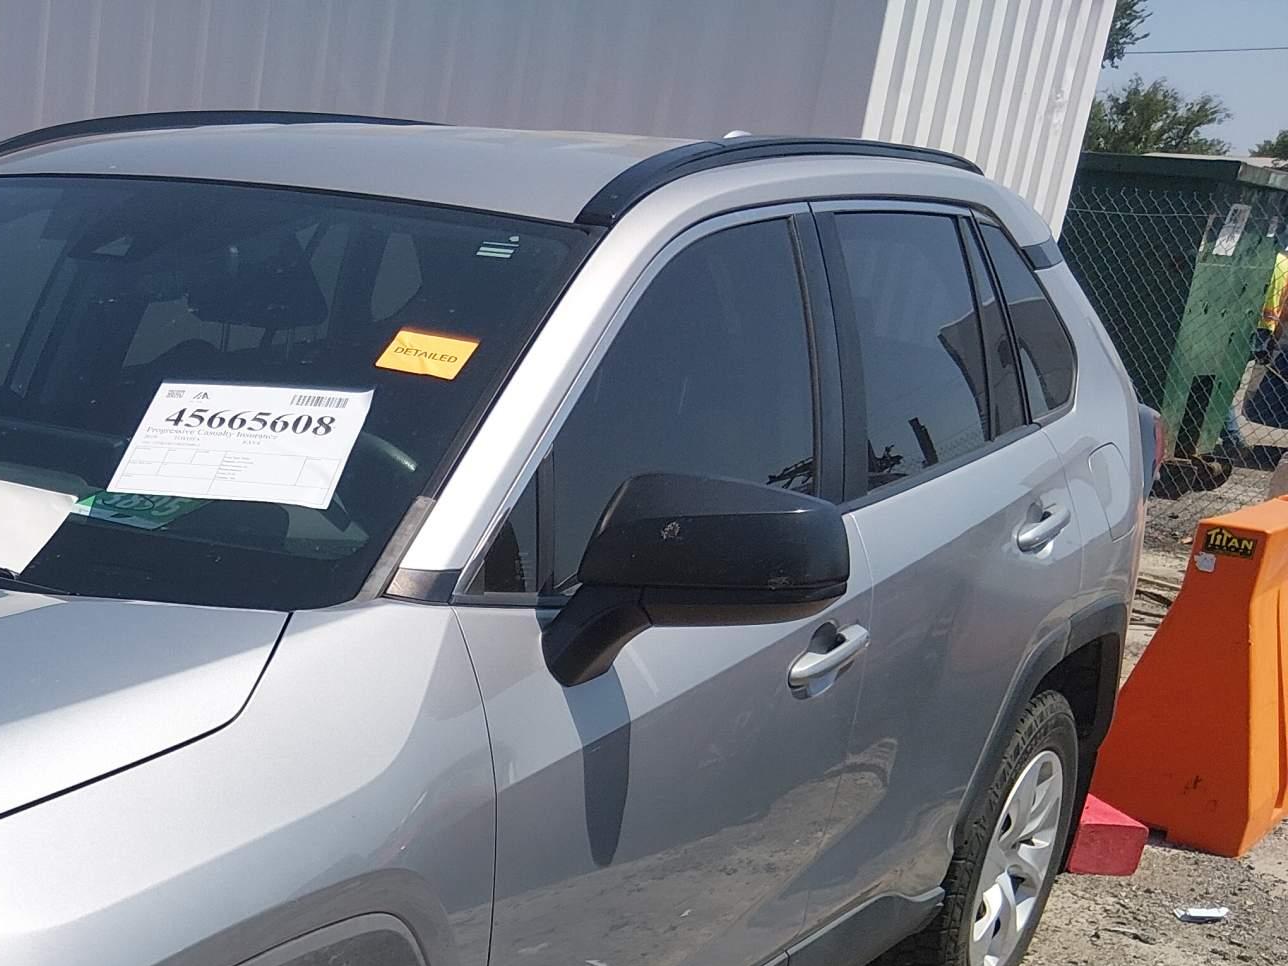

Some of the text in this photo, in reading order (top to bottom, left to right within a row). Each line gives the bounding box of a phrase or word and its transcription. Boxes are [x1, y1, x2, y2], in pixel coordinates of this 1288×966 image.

[393, 346, 459, 364] DETAILED
[165, 407, 336, 437] 45665608
[1207, 528, 1254, 550] TITAN
